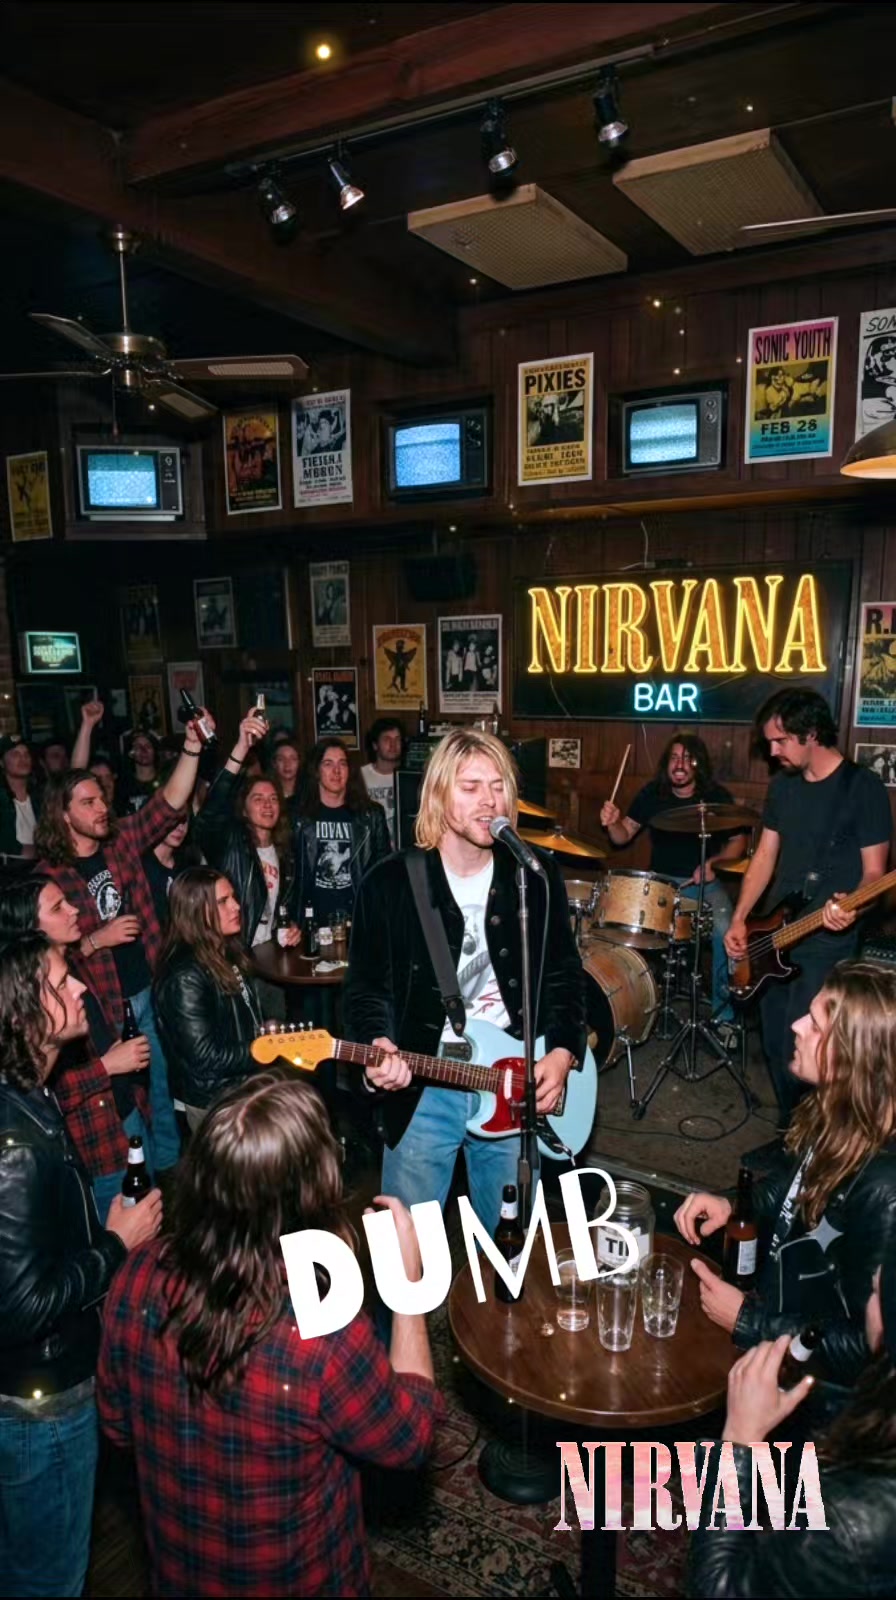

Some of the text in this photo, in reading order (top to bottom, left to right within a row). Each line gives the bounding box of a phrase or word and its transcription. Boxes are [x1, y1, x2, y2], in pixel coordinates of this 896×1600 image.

[755, 327, 831, 364] SONIC YOUTH
[525, 368, 586, 395] PIXIES
[761, 421, 790, 435] FEB
[528, 574, 827, 673] NIRVANA
[633, 682, 698, 712] BAR
